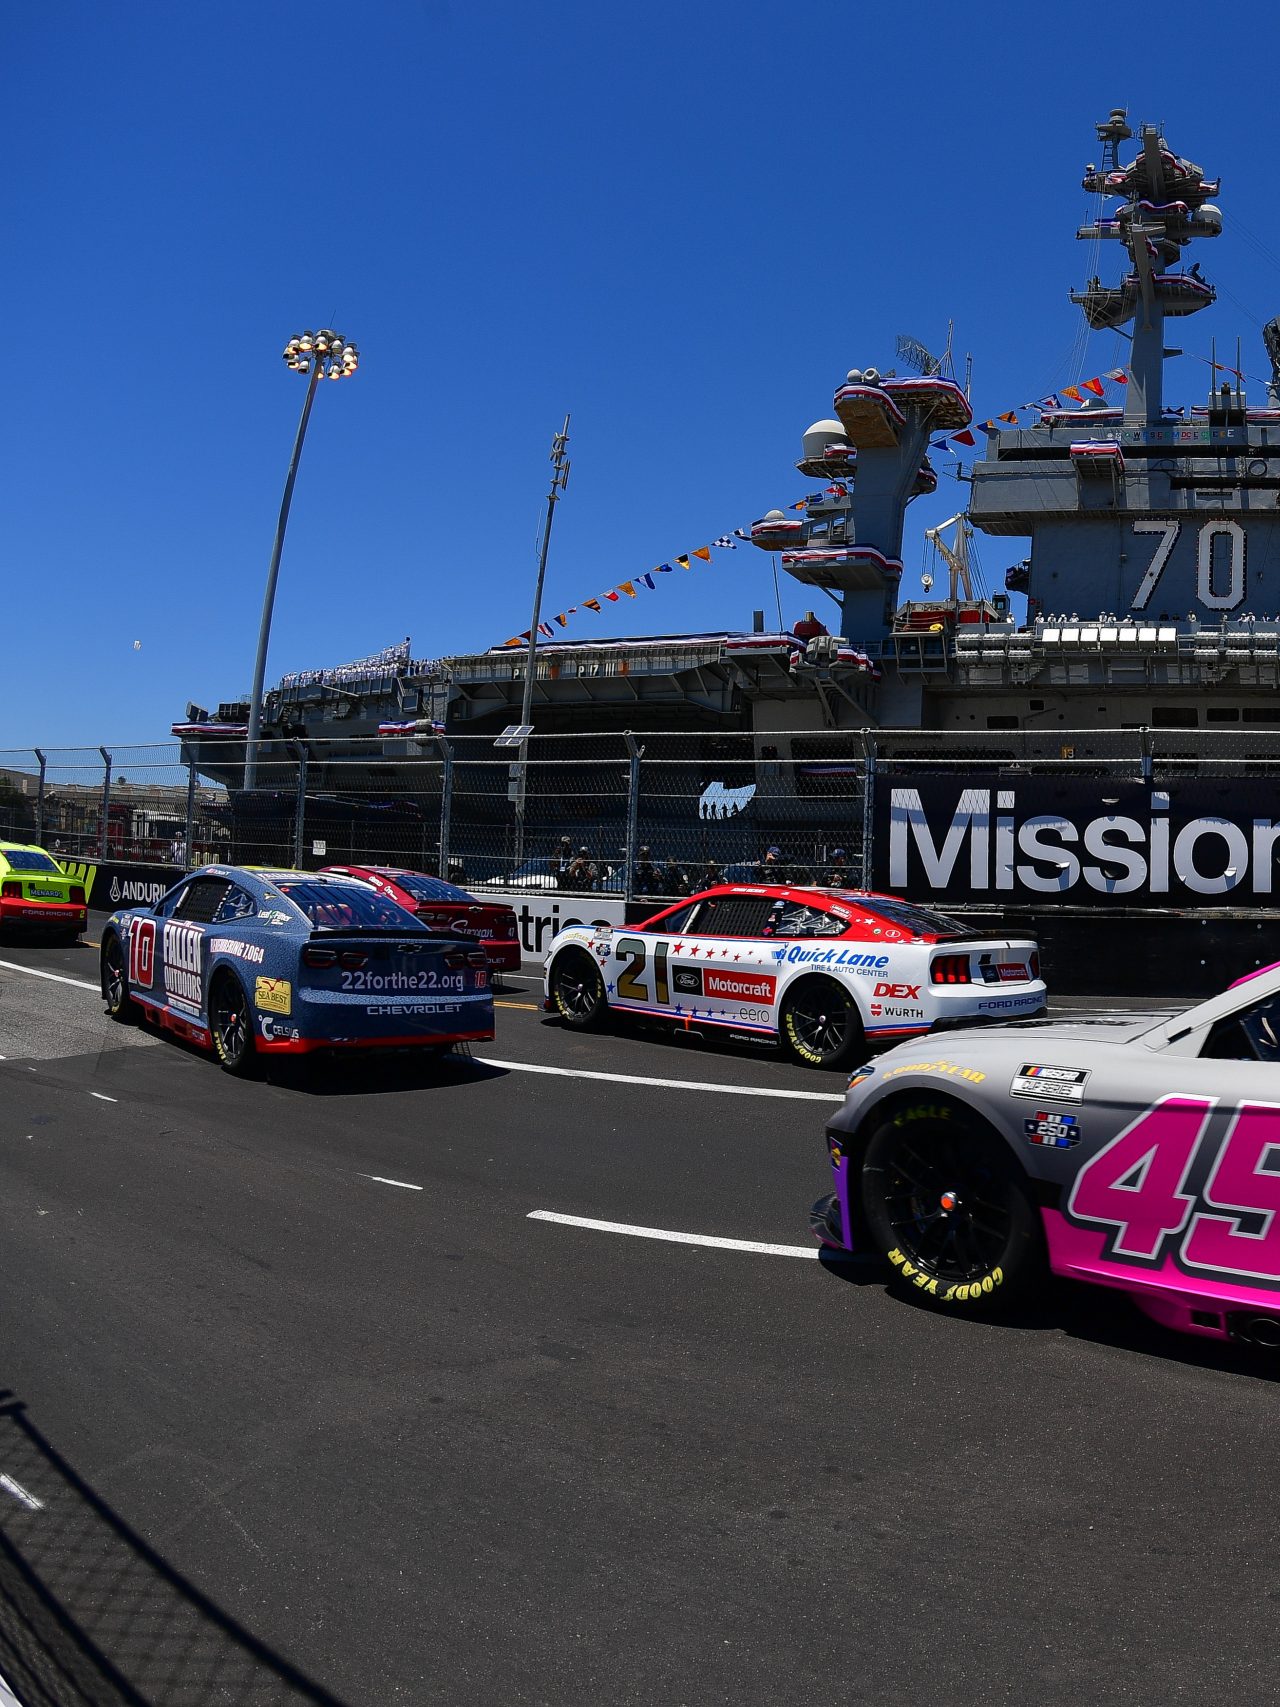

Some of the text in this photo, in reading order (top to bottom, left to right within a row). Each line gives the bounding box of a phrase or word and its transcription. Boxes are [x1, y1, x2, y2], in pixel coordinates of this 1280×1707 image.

[1132, 519, 1246, 611] 70
[578, 665, 585, 678] P
[589, 664, 599, 677] 17
[1063, 748, 1074, 759] 13
[30, 889, 64, 898] MENARDS
[79, 909, 86, 919] 2
[507, 927, 515, 937] 47
[128, 916, 157, 990] 10
[163, 923, 203, 974] FALLEN
[787, 945, 890, 969] Quick Lane
[616, 937, 670, 1005] 21
[811, 963, 826, 972] TIRE
[832, 965, 855, 974] AUTO
[856, 968, 889, 978] CENTER
[164, 965, 203, 1003] OUTDOORS
[341, 971, 464, 991] 22forthe22.org
[474, 971, 486, 988] 10
[708, 976, 773, 998] Motorcraft
[258, 990, 288, 1006] SEA BEST
[873, 982, 922, 1000] DEX
[367, 1004, 463, 1015] CHEVROLET
[978, 995, 1043, 1010] FORD RACING
[739, 1007, 770, 1023] eero
[884, 1006, 924, 1019] WÜRTH
[273, 1025, 300, 1039] CELSIUS
[729, 1033, 778, 1045] FORD RACING
[882, 1059, 988, 1085] GOODYEAR
[1040, 1082, 1074, 1096] SERIES
[1037, 1121, 1068, 1138] 250
[887, 1247, 1004, 1301] GOODYEAR
